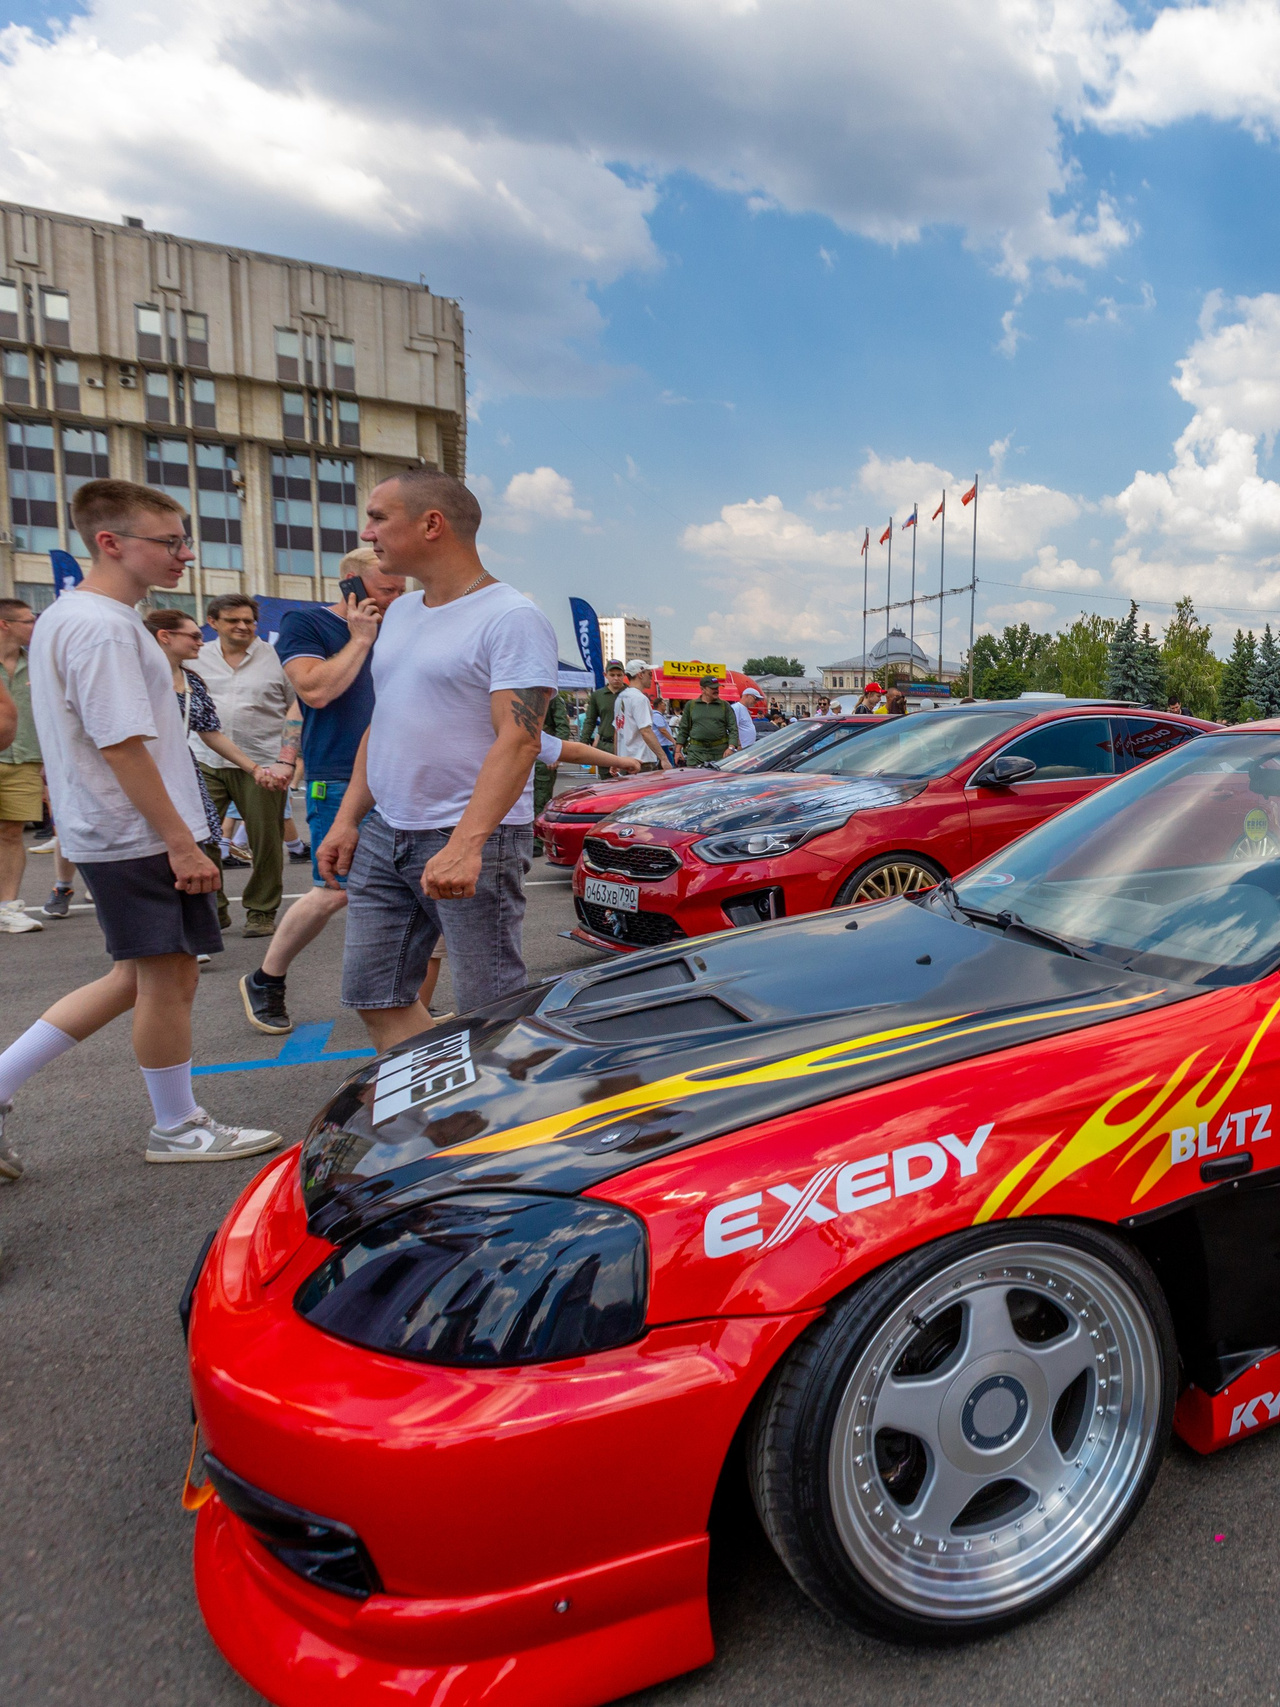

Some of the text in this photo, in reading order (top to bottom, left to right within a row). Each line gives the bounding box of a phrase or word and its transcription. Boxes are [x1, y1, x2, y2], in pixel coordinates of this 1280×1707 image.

[579, 619, 594, 673] ATON
[620, 887, 637, 903] 790
[1170, 1103, 1272, 1166] BLITZ
[703, 1122, 996, 1259] EXEDY
